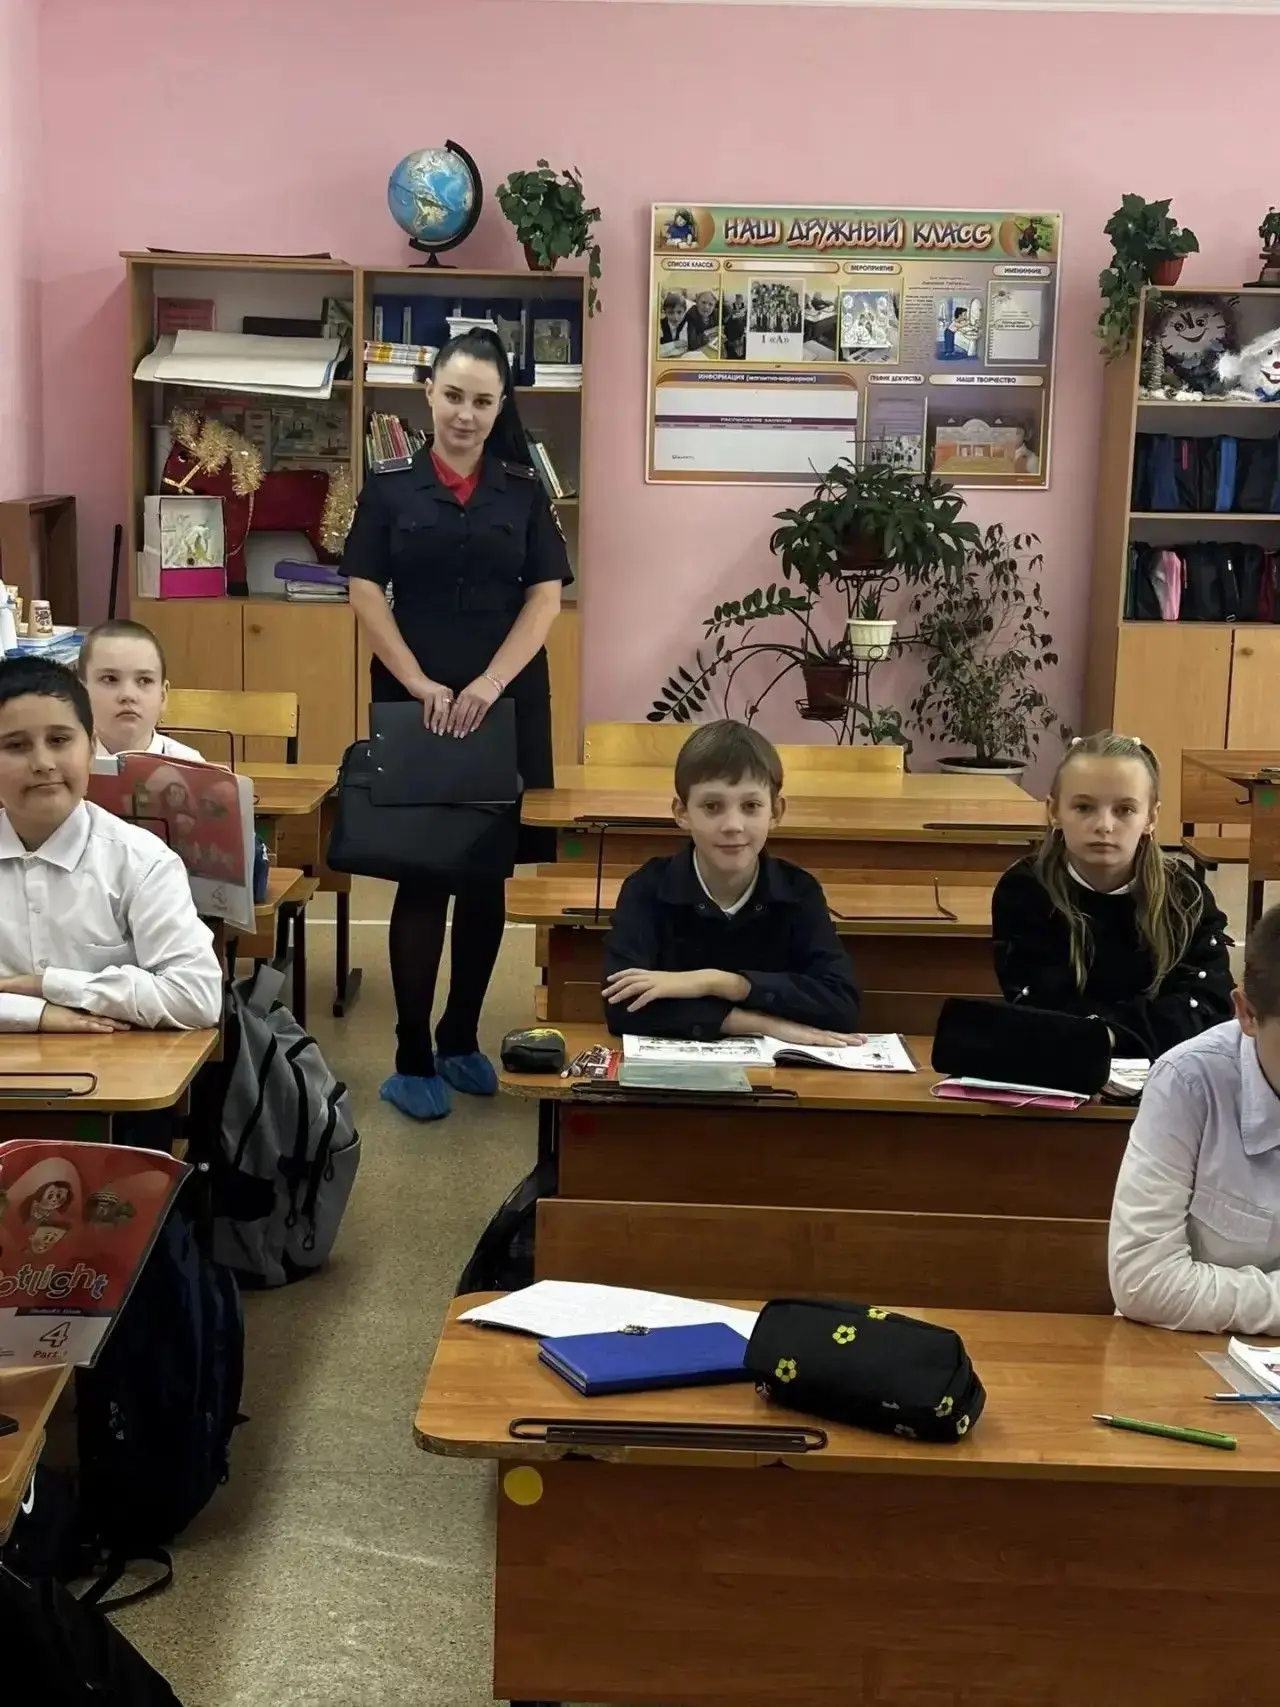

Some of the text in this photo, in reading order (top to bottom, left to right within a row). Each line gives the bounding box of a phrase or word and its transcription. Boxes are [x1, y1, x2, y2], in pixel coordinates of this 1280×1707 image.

[724, 217, 994, 252] НАШ ДРУЖНЫЙ КЛАСС
[698, 374, 745, 382] ИНФОРМАЦИЯ
[976, 376, 1017, 384] ТВОРЧЕСТВО
[0, 1263, 109, 1299] otlight
[39, 1321, 71, 1348] 4
